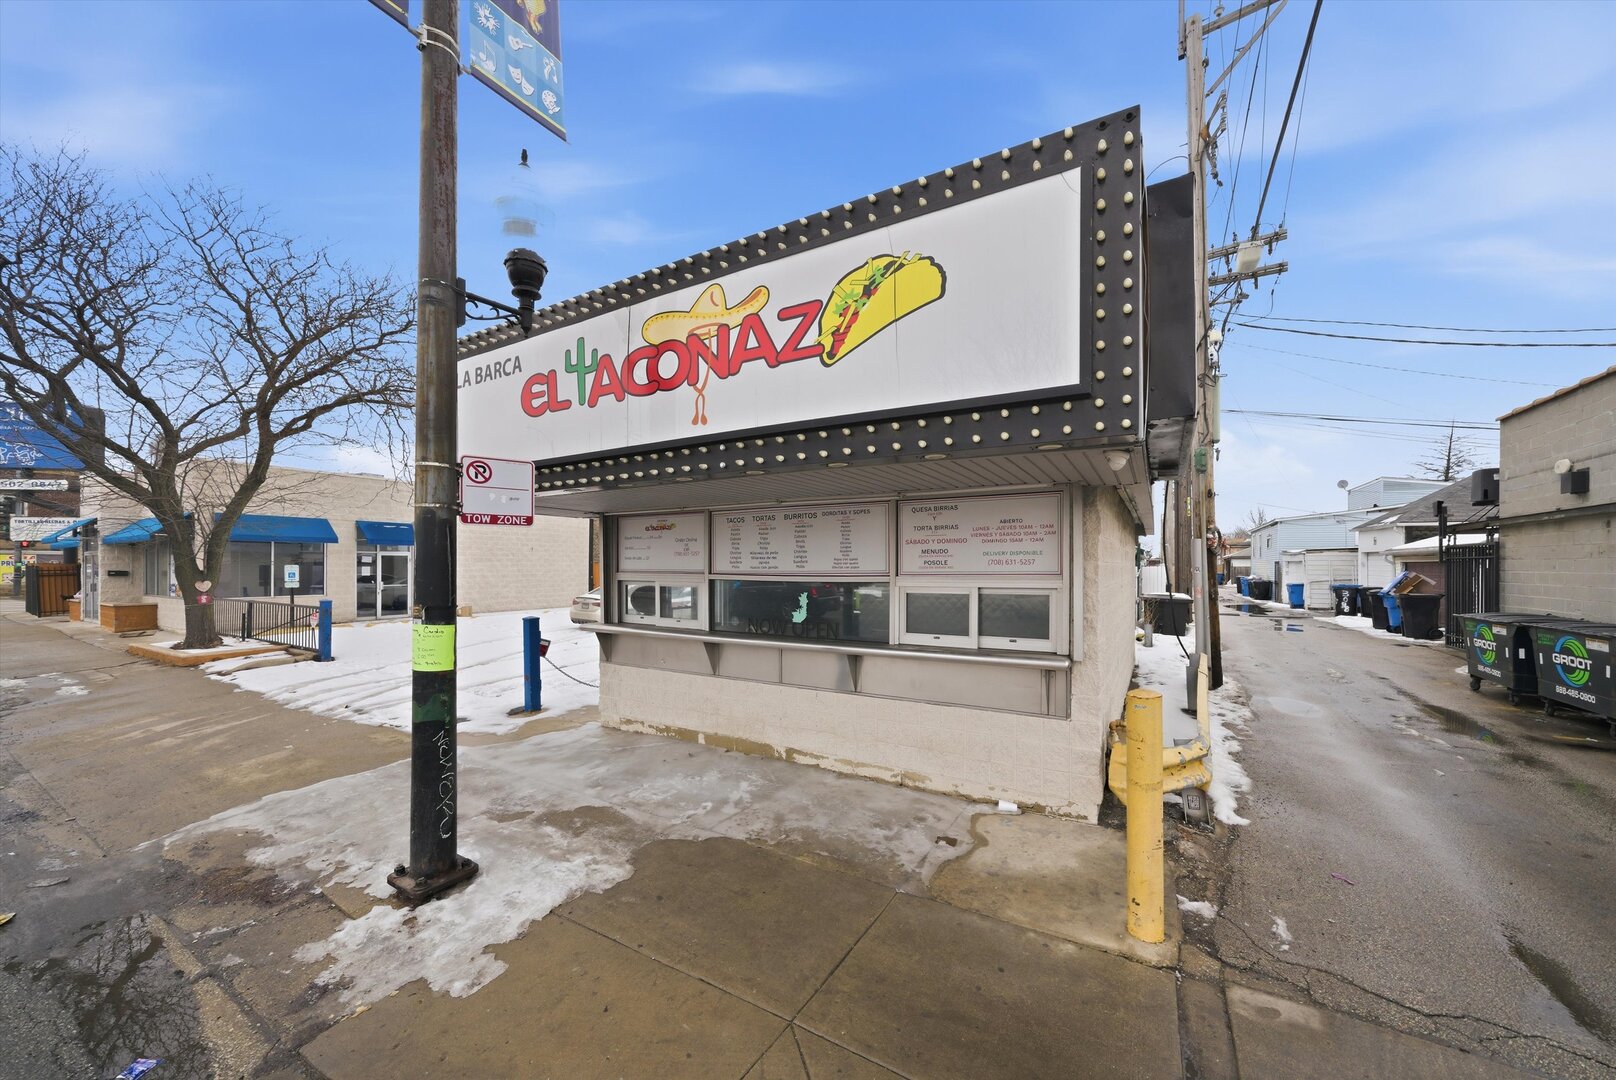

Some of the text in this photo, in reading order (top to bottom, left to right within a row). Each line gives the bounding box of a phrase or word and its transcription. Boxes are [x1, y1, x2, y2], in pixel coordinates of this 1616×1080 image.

[475, 355, 522, 384] BARCA
[520, 371, 572, 417] EL
[911, 506, 932, 514] QUESA
[933, 504, 959, 512] BIRRIAS
[466, 513, 528, 525] TOW ZONE
[726, 516, 745, 524] TACOS
[752, 514, 776, 522] TORTAS
[783, 512, 818, 521] BURRITOS
[936, 537, 968, 545] DOMINGO
[1004, 558, 1036, 566] 631-5257
[747, 617, 840, 640] NOW OPEN
[1473, 638, 1497, 651] GROOT
[1552, 653, 1593, 671] GROOT
